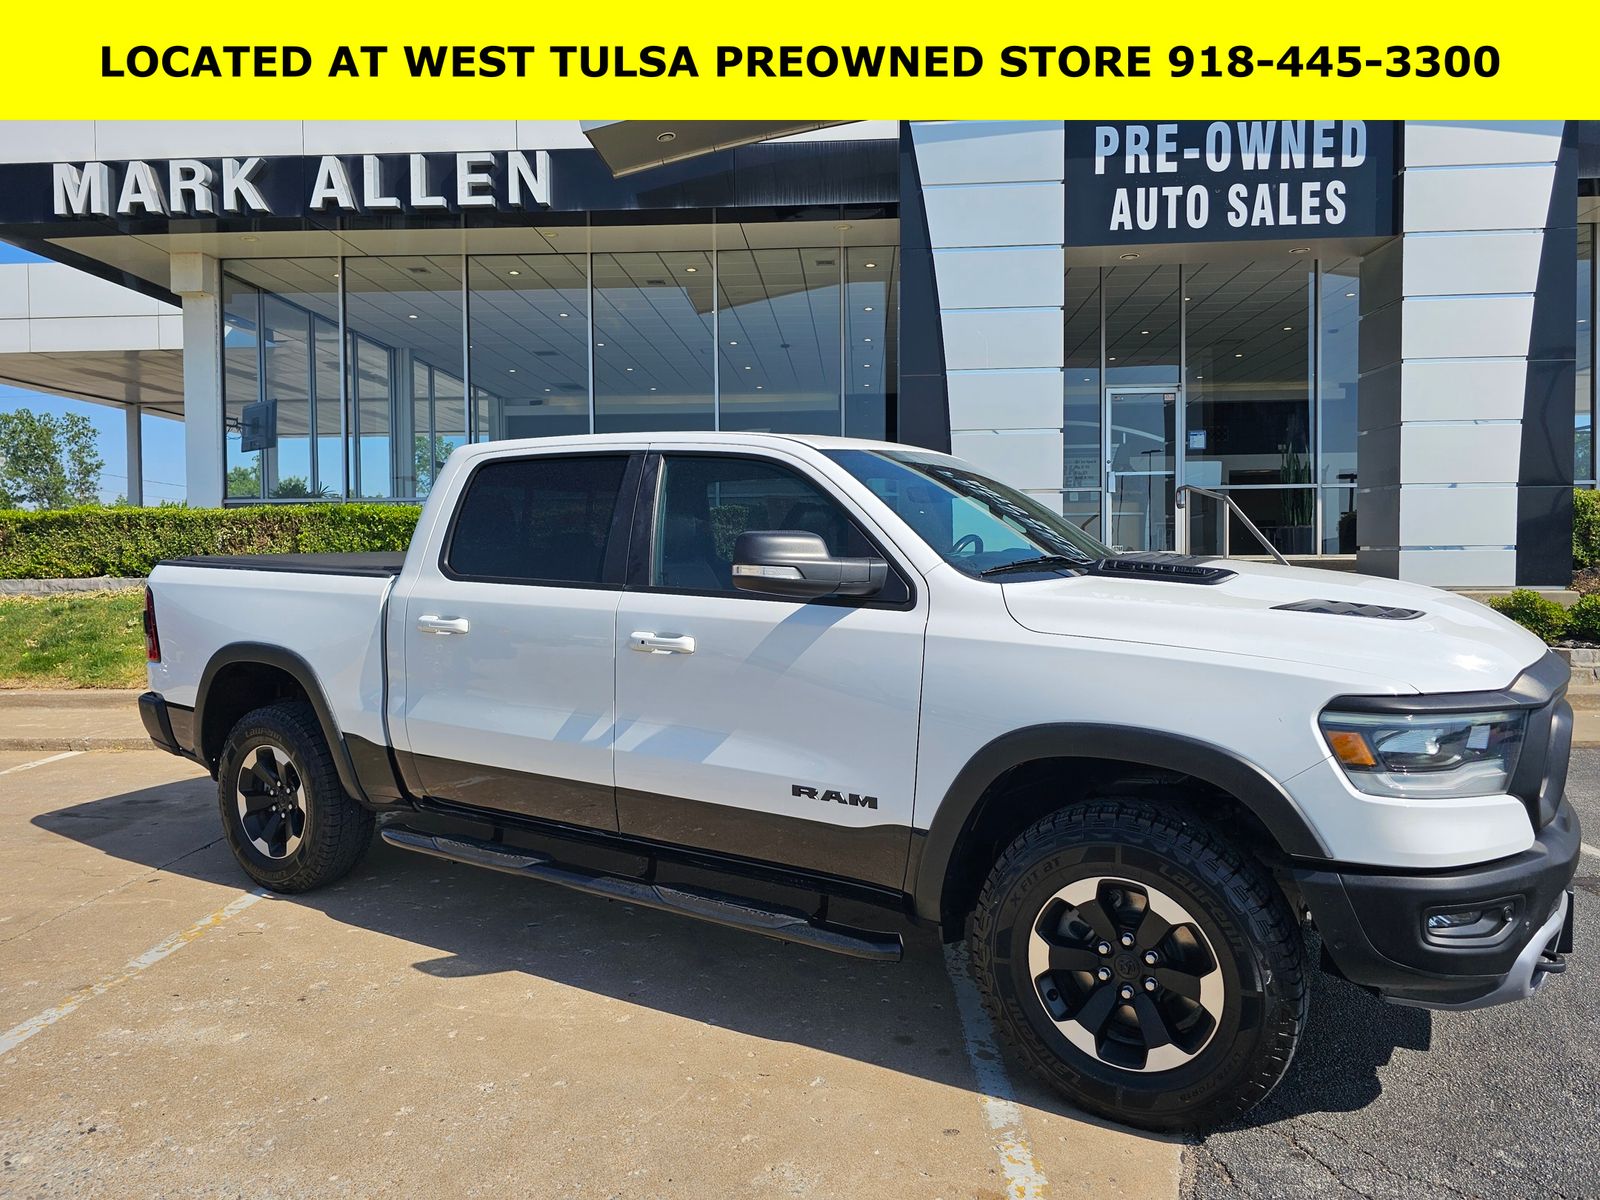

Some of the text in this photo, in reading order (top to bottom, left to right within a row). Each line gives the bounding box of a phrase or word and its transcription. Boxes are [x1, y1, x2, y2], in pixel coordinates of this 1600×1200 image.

[1095, 120, 1367, 175] PRE-OWNED
[53, 150, 551, 217] MARK ALLEN
[1110, 180, 1346, 231] AUTO SALES
[791, 784, 878, 810] RAM
